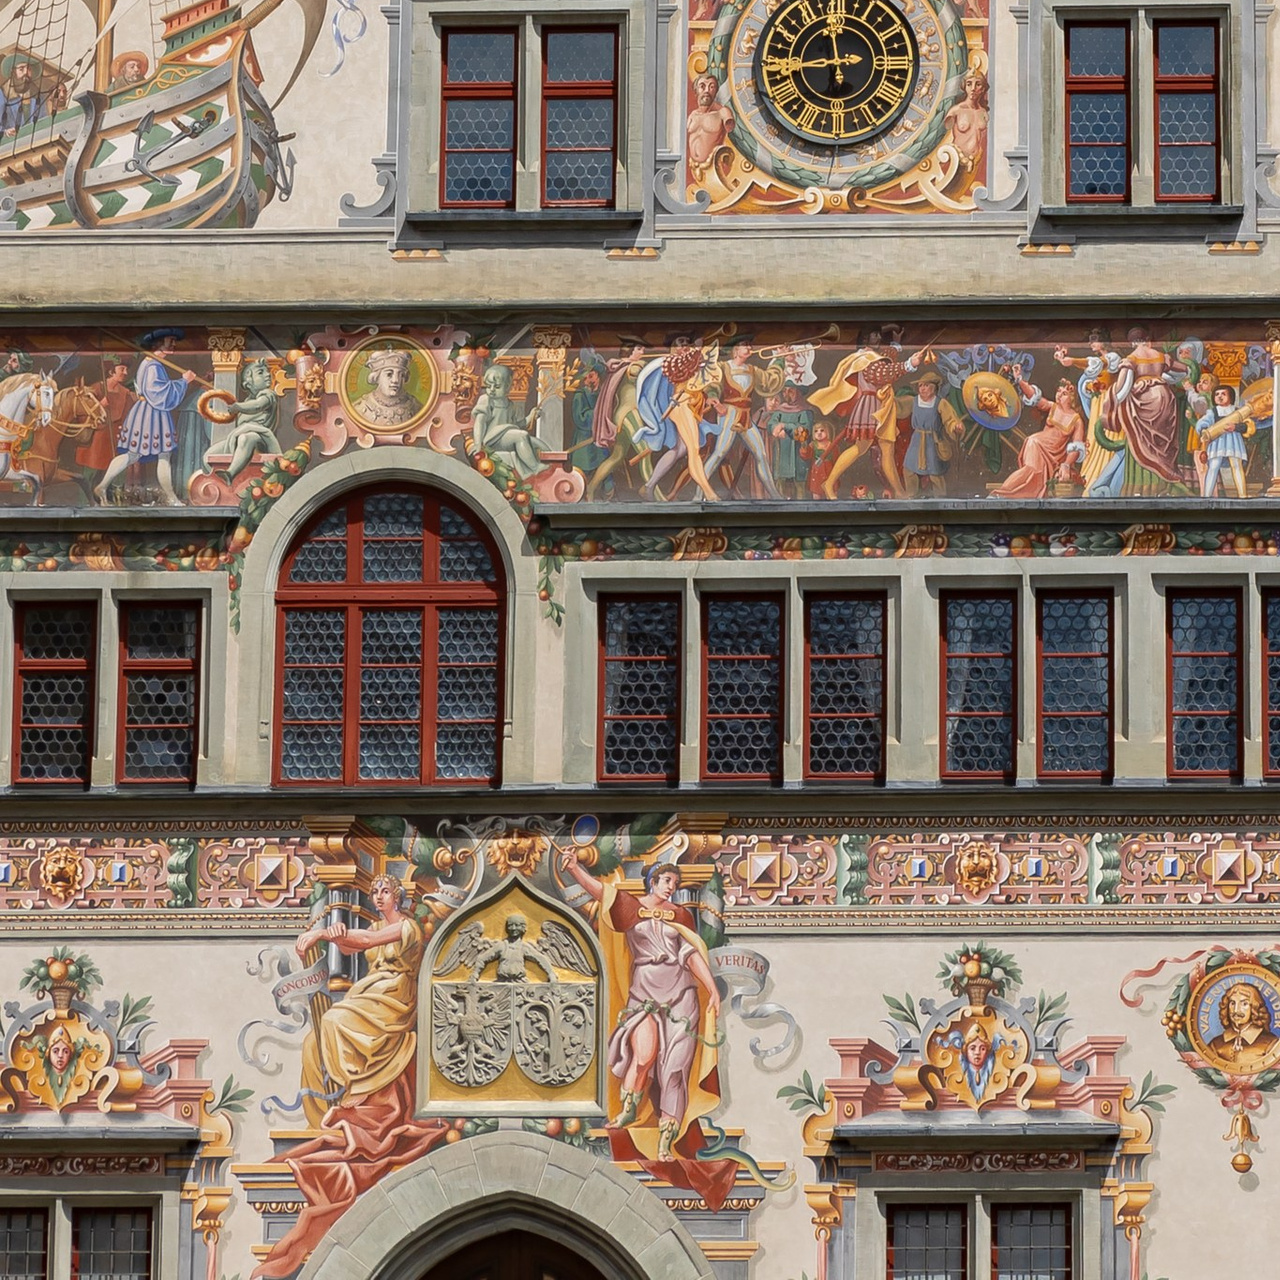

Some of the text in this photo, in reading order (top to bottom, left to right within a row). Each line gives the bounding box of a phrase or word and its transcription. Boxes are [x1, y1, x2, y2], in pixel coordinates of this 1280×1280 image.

[879, 24, 903, 42] II
[886, 56, 909, 70] III
[715, 955, 765, 974] VERITAS
[1200, 977, 1245, 1035] VALENTIN
